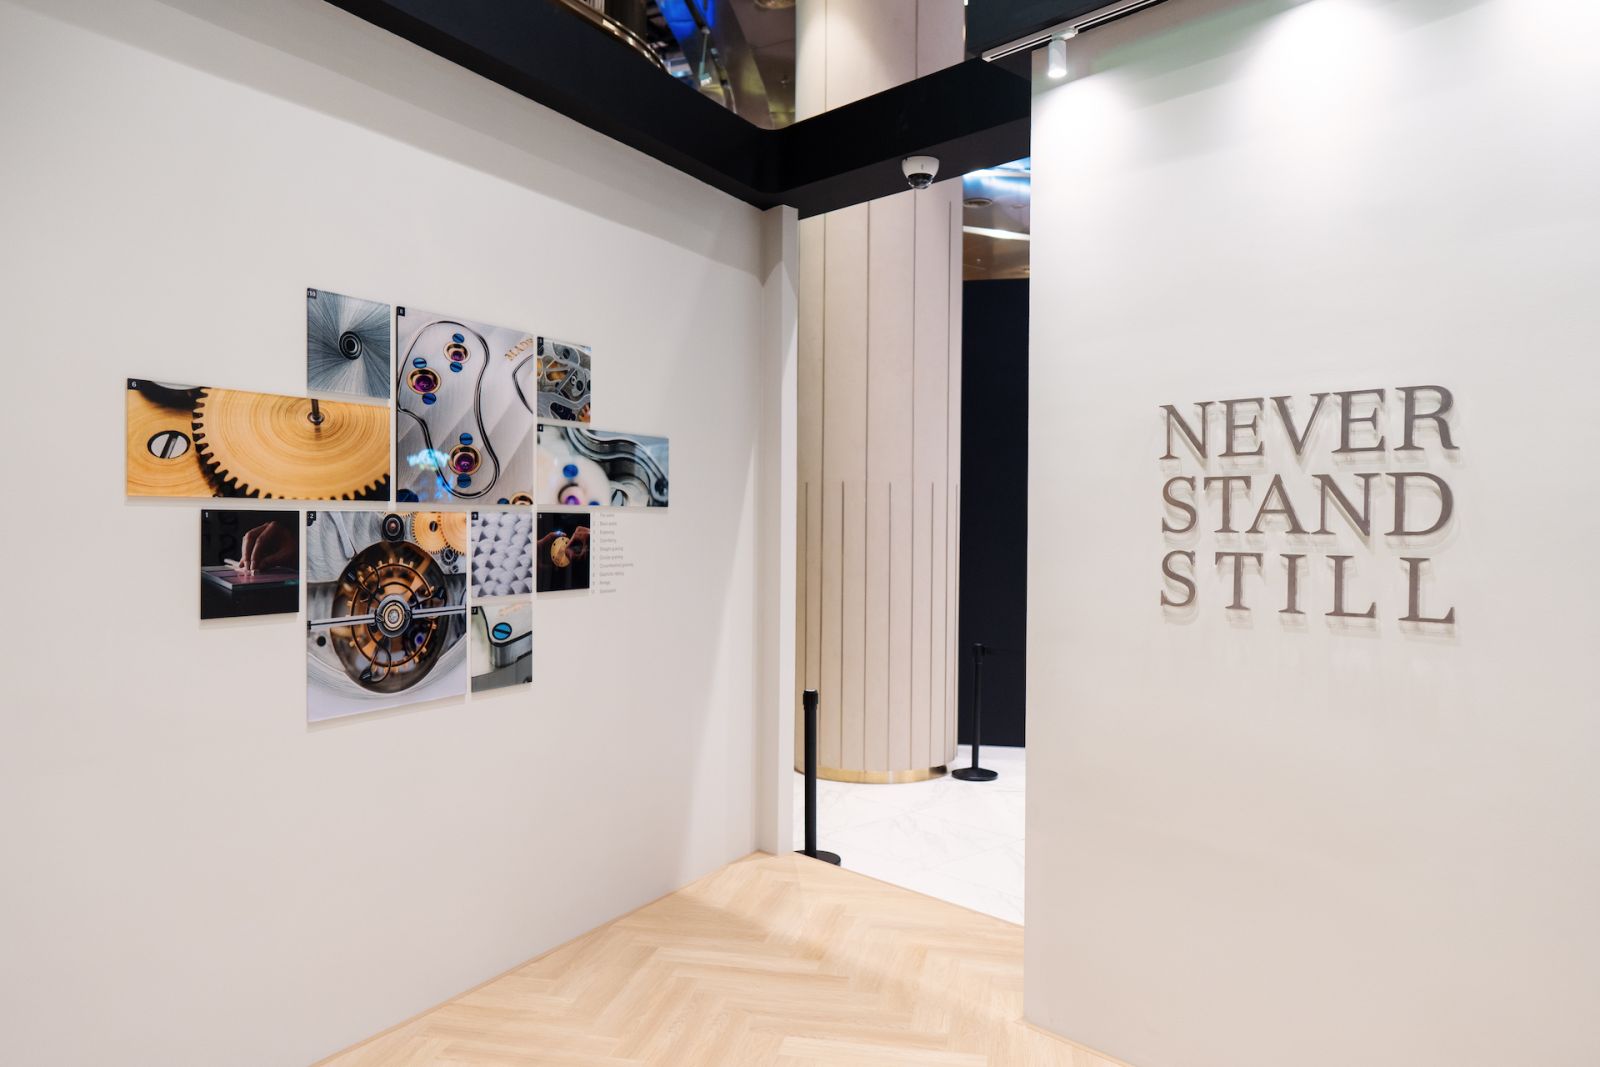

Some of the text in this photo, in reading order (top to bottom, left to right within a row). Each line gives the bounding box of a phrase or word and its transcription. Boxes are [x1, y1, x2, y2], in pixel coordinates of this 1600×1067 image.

[1159, 385, 1460, 460] NEVER
[1161, 471, 1454, 537] STAND
[1160, 550, 1455, 624] STILL
